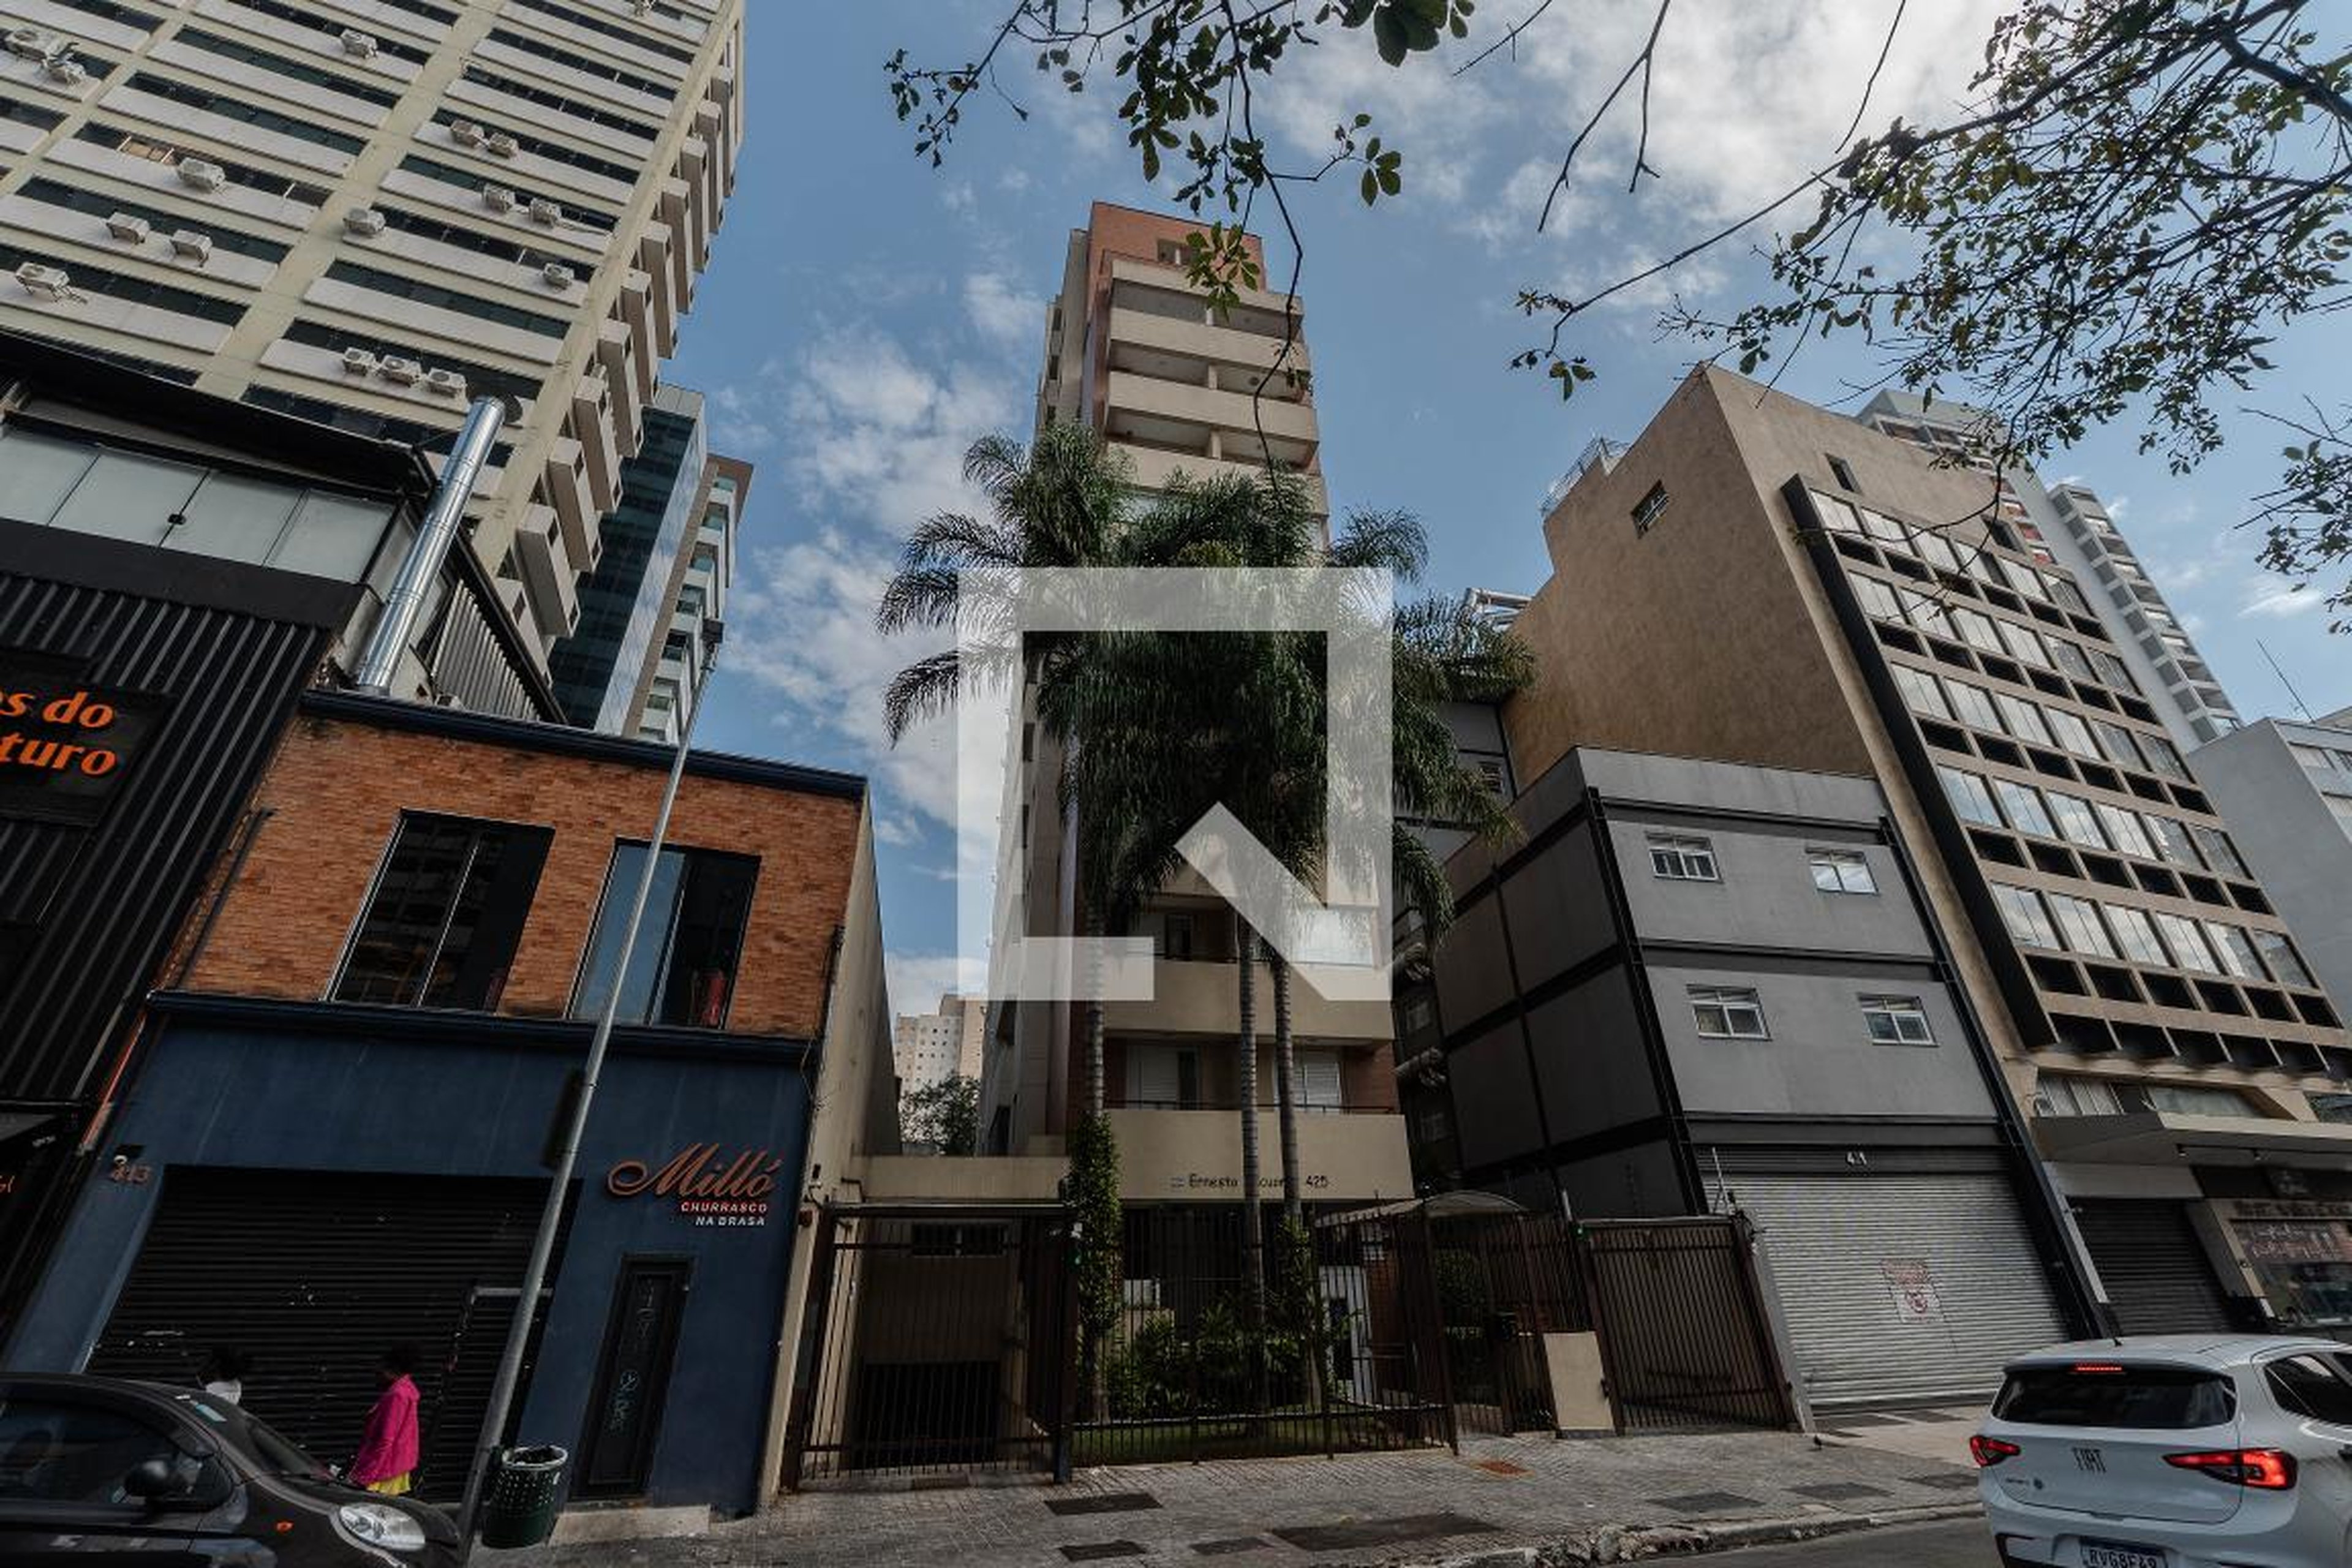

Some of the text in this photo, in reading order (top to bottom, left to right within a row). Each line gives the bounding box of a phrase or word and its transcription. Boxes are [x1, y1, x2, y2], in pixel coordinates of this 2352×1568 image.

[0, 690, 115, 728] s do
[1188, 1173, 1238, 1188] Ernesto
[1306, 1175, 1328, 1188] 425
[680, 1201, 767, 1213] CHURRASCO
[695, 1216, 714, 1226] NA
[2071, 1447, 2106, 1474] FIAT
